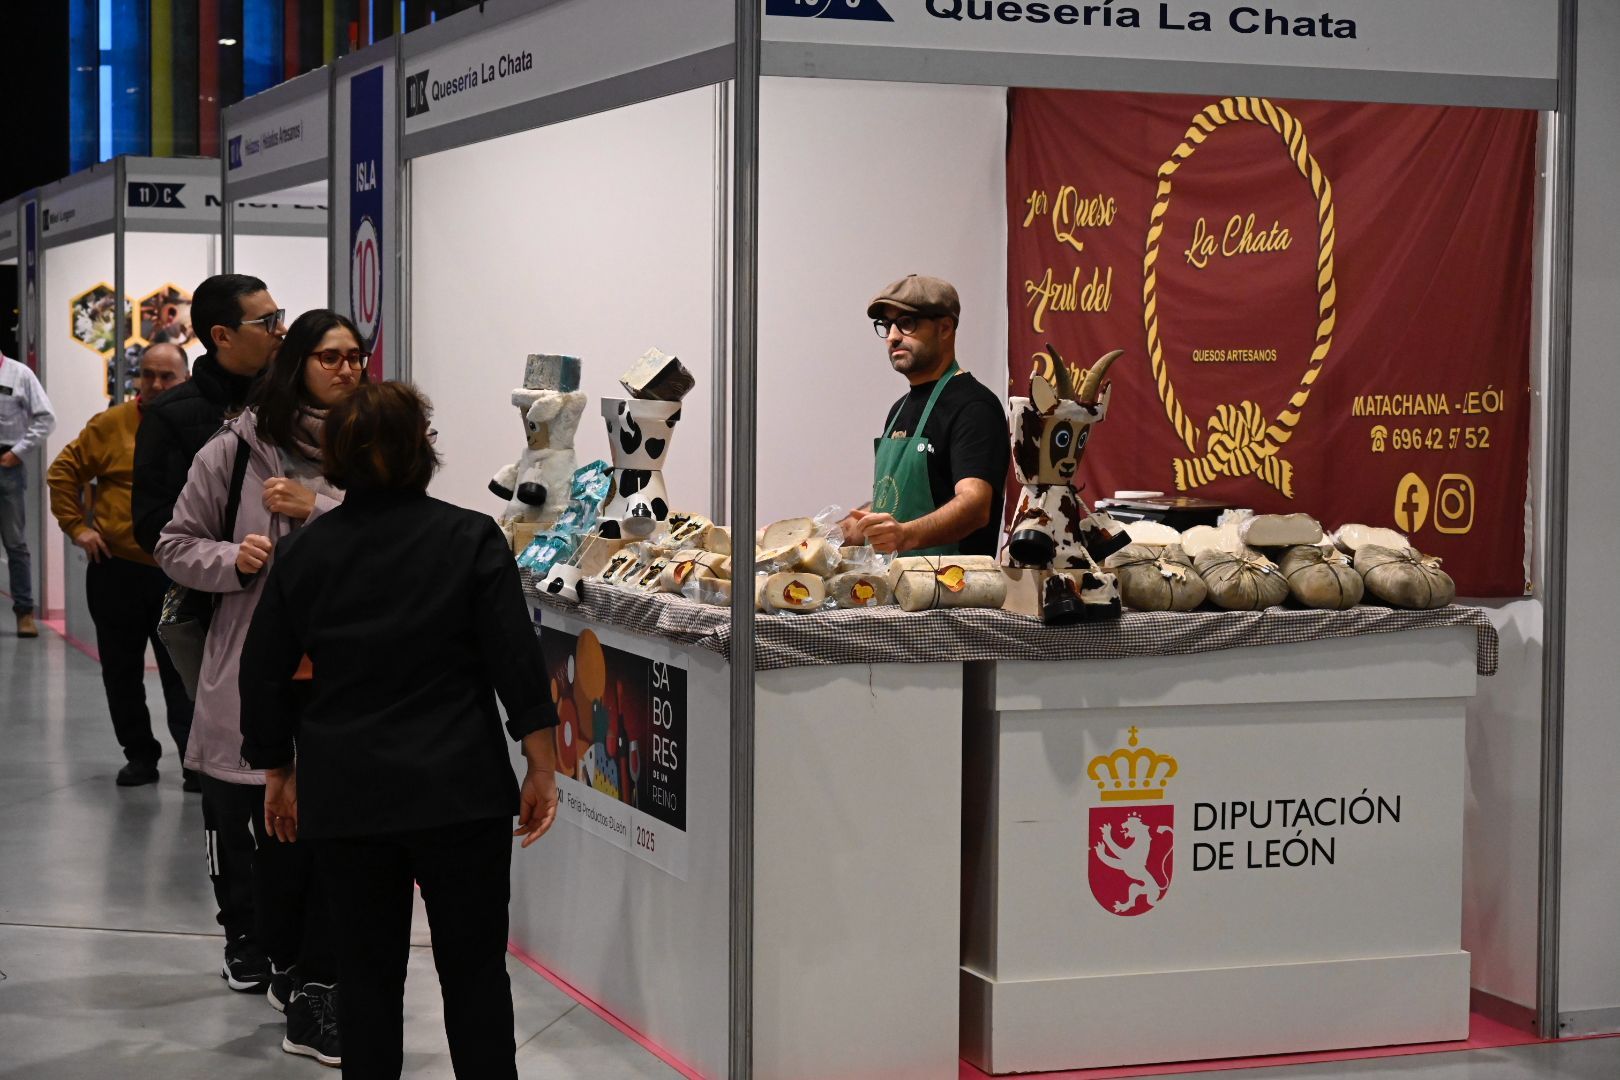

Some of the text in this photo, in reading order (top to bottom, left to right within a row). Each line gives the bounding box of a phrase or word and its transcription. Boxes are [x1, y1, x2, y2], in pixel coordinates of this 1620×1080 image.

[925, 0, 1358, 39] Quesería La Chata
[431, 67, 478, 102] Quesería
[481, 63, 495, 84] La
[498, 50, 533, 78] Chata
[356, 159, 376, 192] ISLA
[139, 187, 172, 204] 11 C
[1052, 185, 1117, 252] Queso
[1184, 212, 1293, 269] La Chata
[356, 238, 376, 324] 10
[1025, 266, 1113, 333] Azul del
[1192, 349, 1277, 363] QUESOS ARTESANOS
[1351, 393, 1450, 417] MATACHANA
[1392, 428, 1422, 450] 696
[1424, 428, 1444, 449] 42
[1464, 426, 1490, 449] 52
[652, 659, 670, 692] SA
[652, 696, 673, 730] BO
[652, 733, 678, 771] RES
[652, 770, 668, 784] DE UN
[652, 784, 677, 811] REINO
[1192, 787, 1401, 832] DIPUTACIÓN
[567, 792, 582, 813] Feria
[636, 825, 655, 852] 2025
[1192, 829, 1336, 872] DE LEÓN
